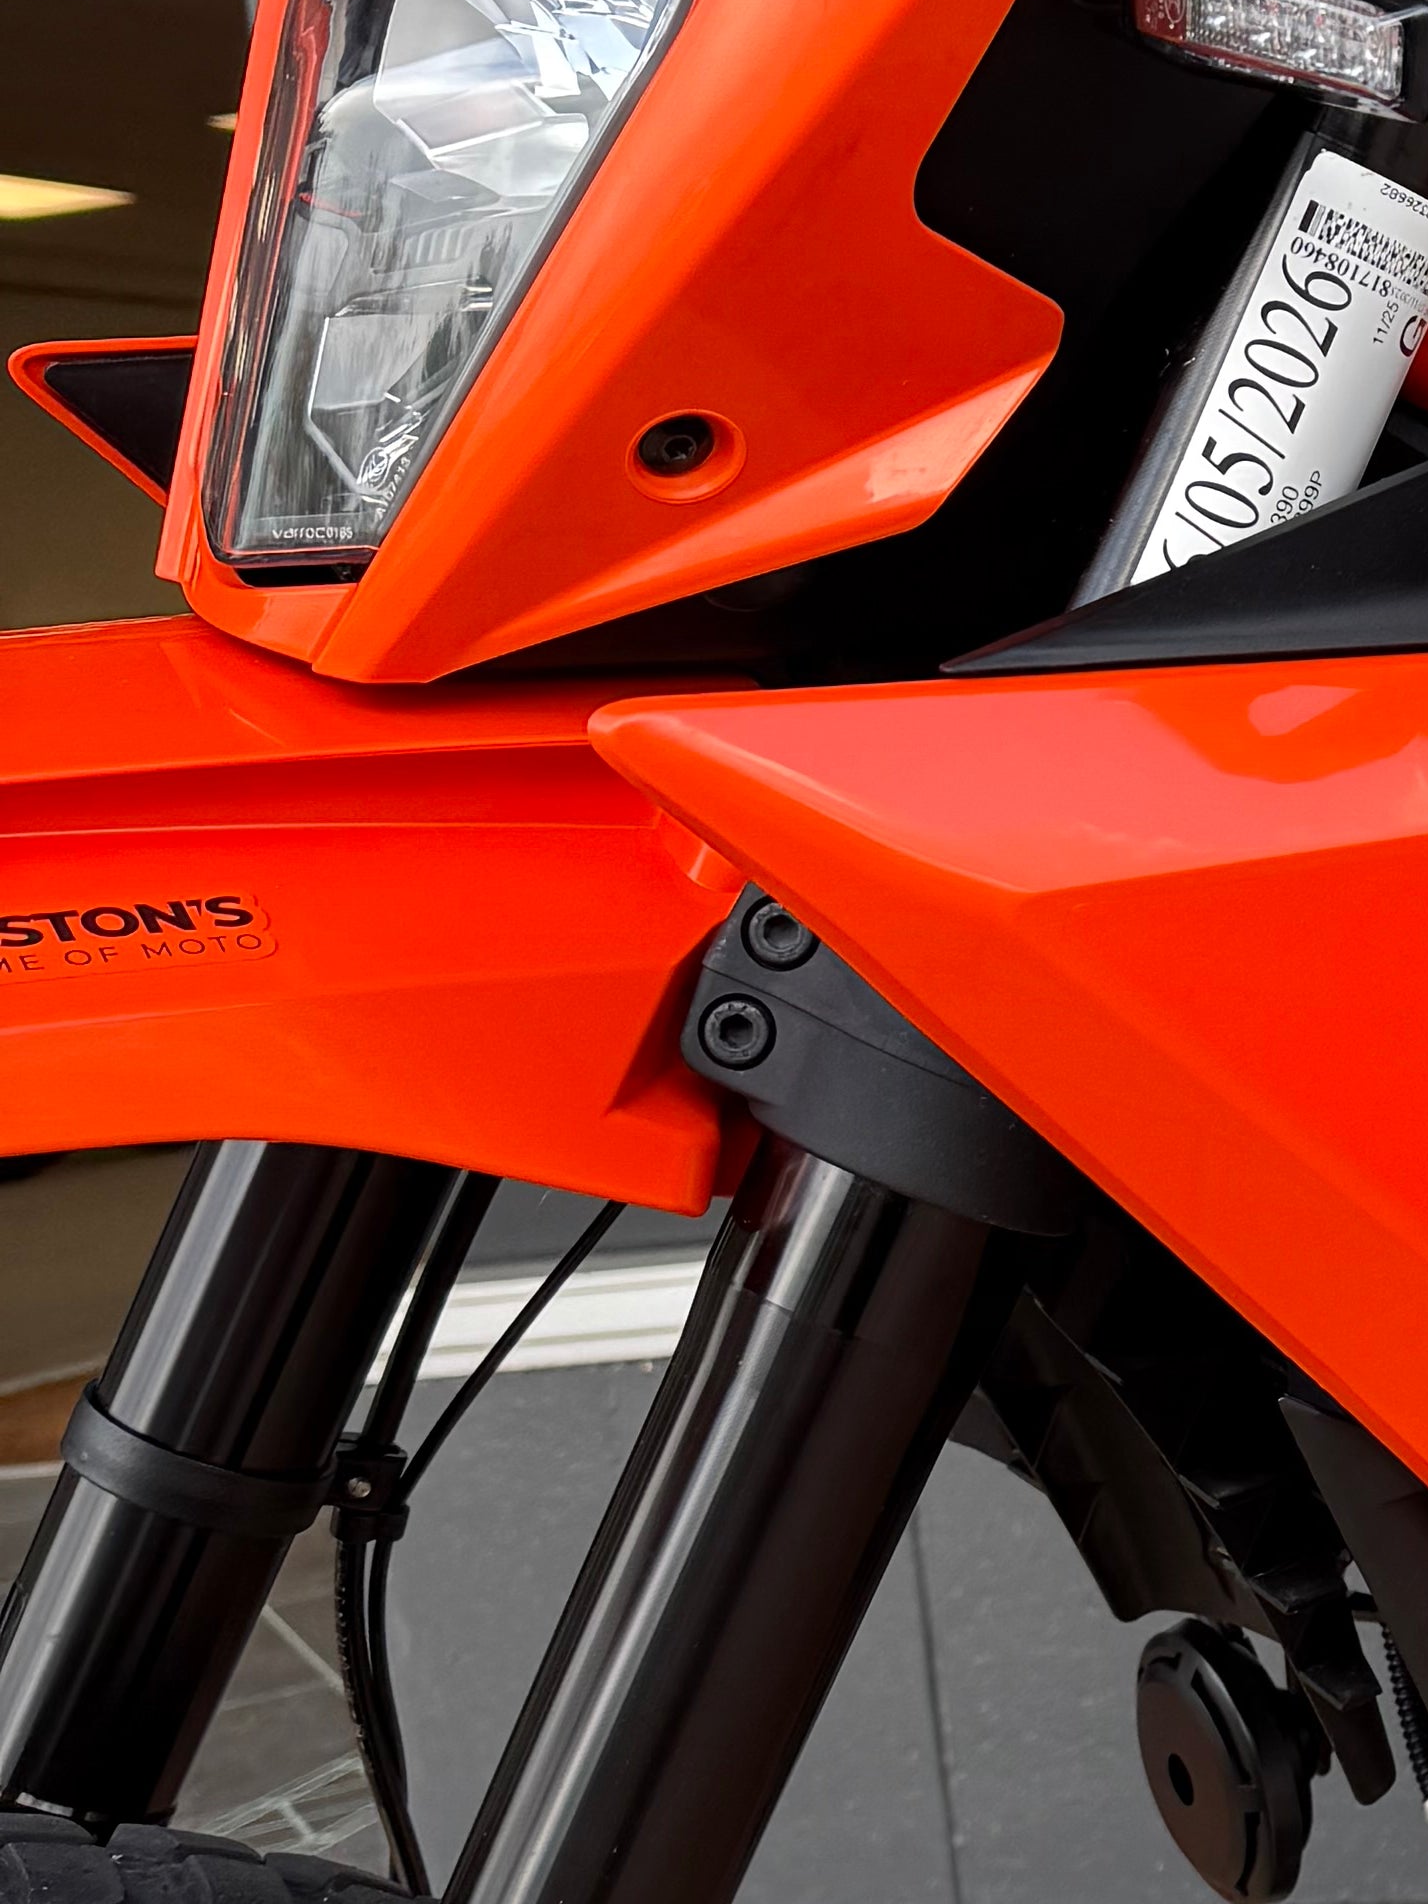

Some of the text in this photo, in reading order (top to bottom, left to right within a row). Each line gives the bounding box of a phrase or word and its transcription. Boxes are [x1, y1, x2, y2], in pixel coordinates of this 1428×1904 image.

[1290, 236, 1393, 298] 817108460
[1163, 253, 1353, 570] /05/2026
[1293, 470, 1325, 519] 99P
[64, 946, 120, 967] OF
[141, 933, 262, 960] MOTO
